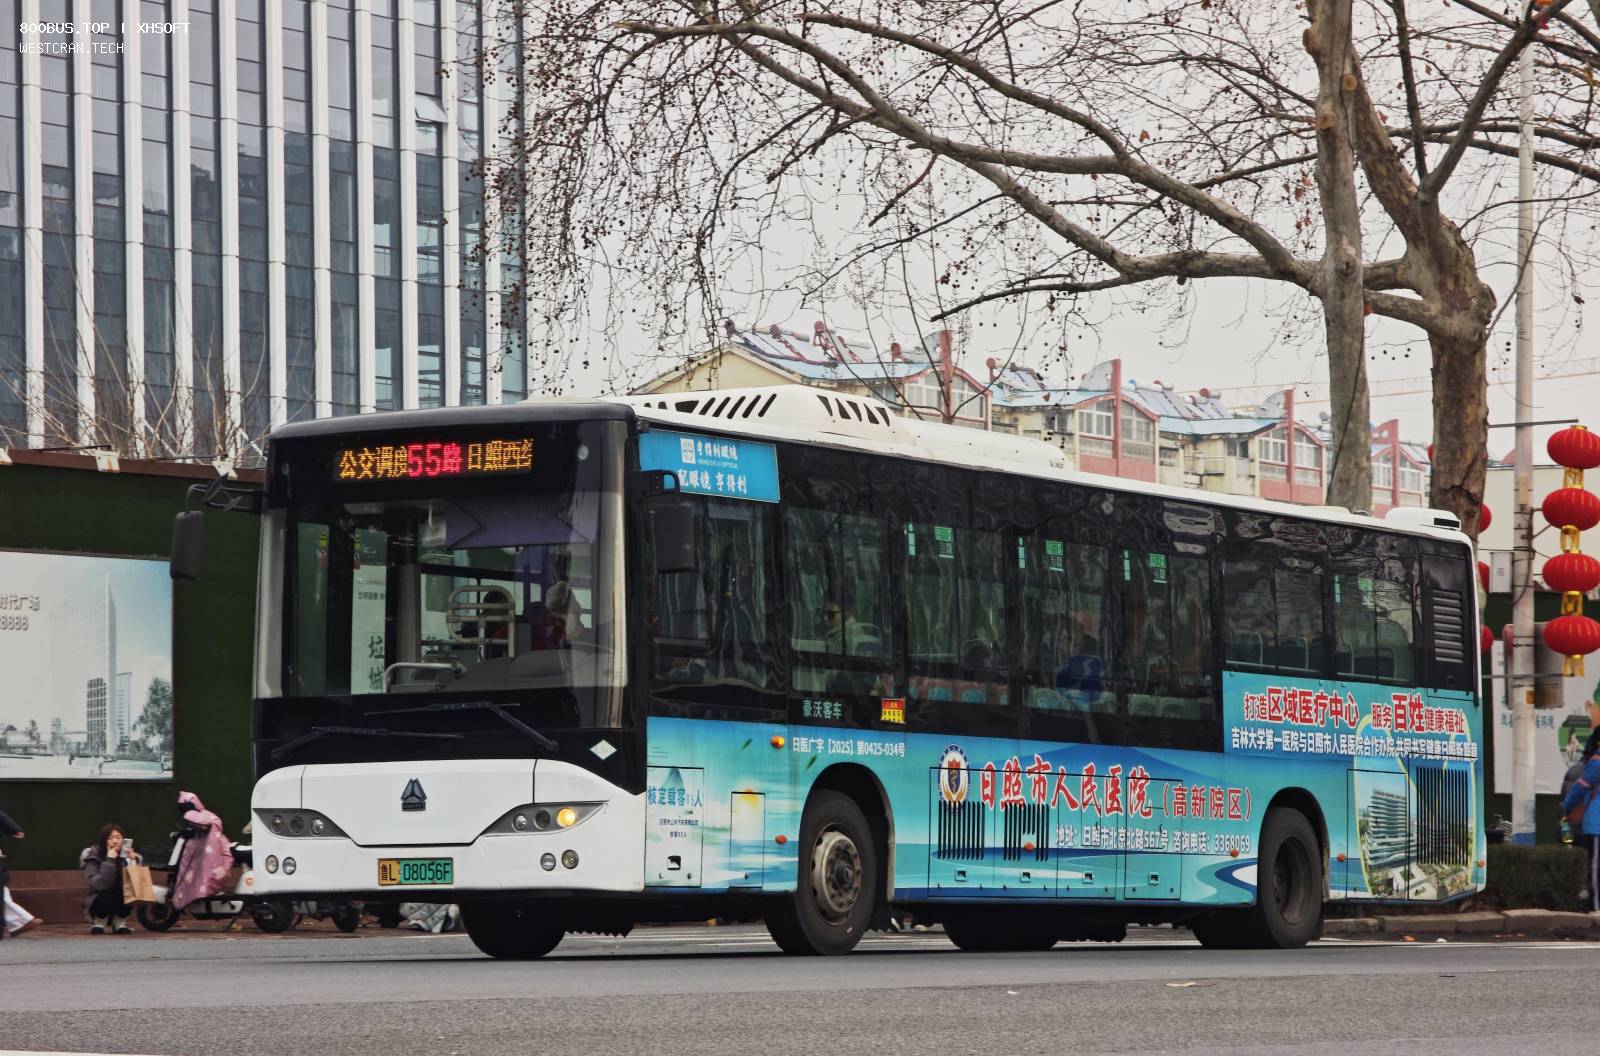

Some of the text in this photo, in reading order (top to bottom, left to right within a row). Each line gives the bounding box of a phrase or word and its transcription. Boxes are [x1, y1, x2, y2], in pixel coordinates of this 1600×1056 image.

[803, 699, 842, 719] 豪沃客车
[1244, 686, 1466, 735] 打造区域医疗中心 服务百姓健康福祉
[980, 754, 1153, 818] 日照市人民医院
[403, 863, 450, 881] 08056F
